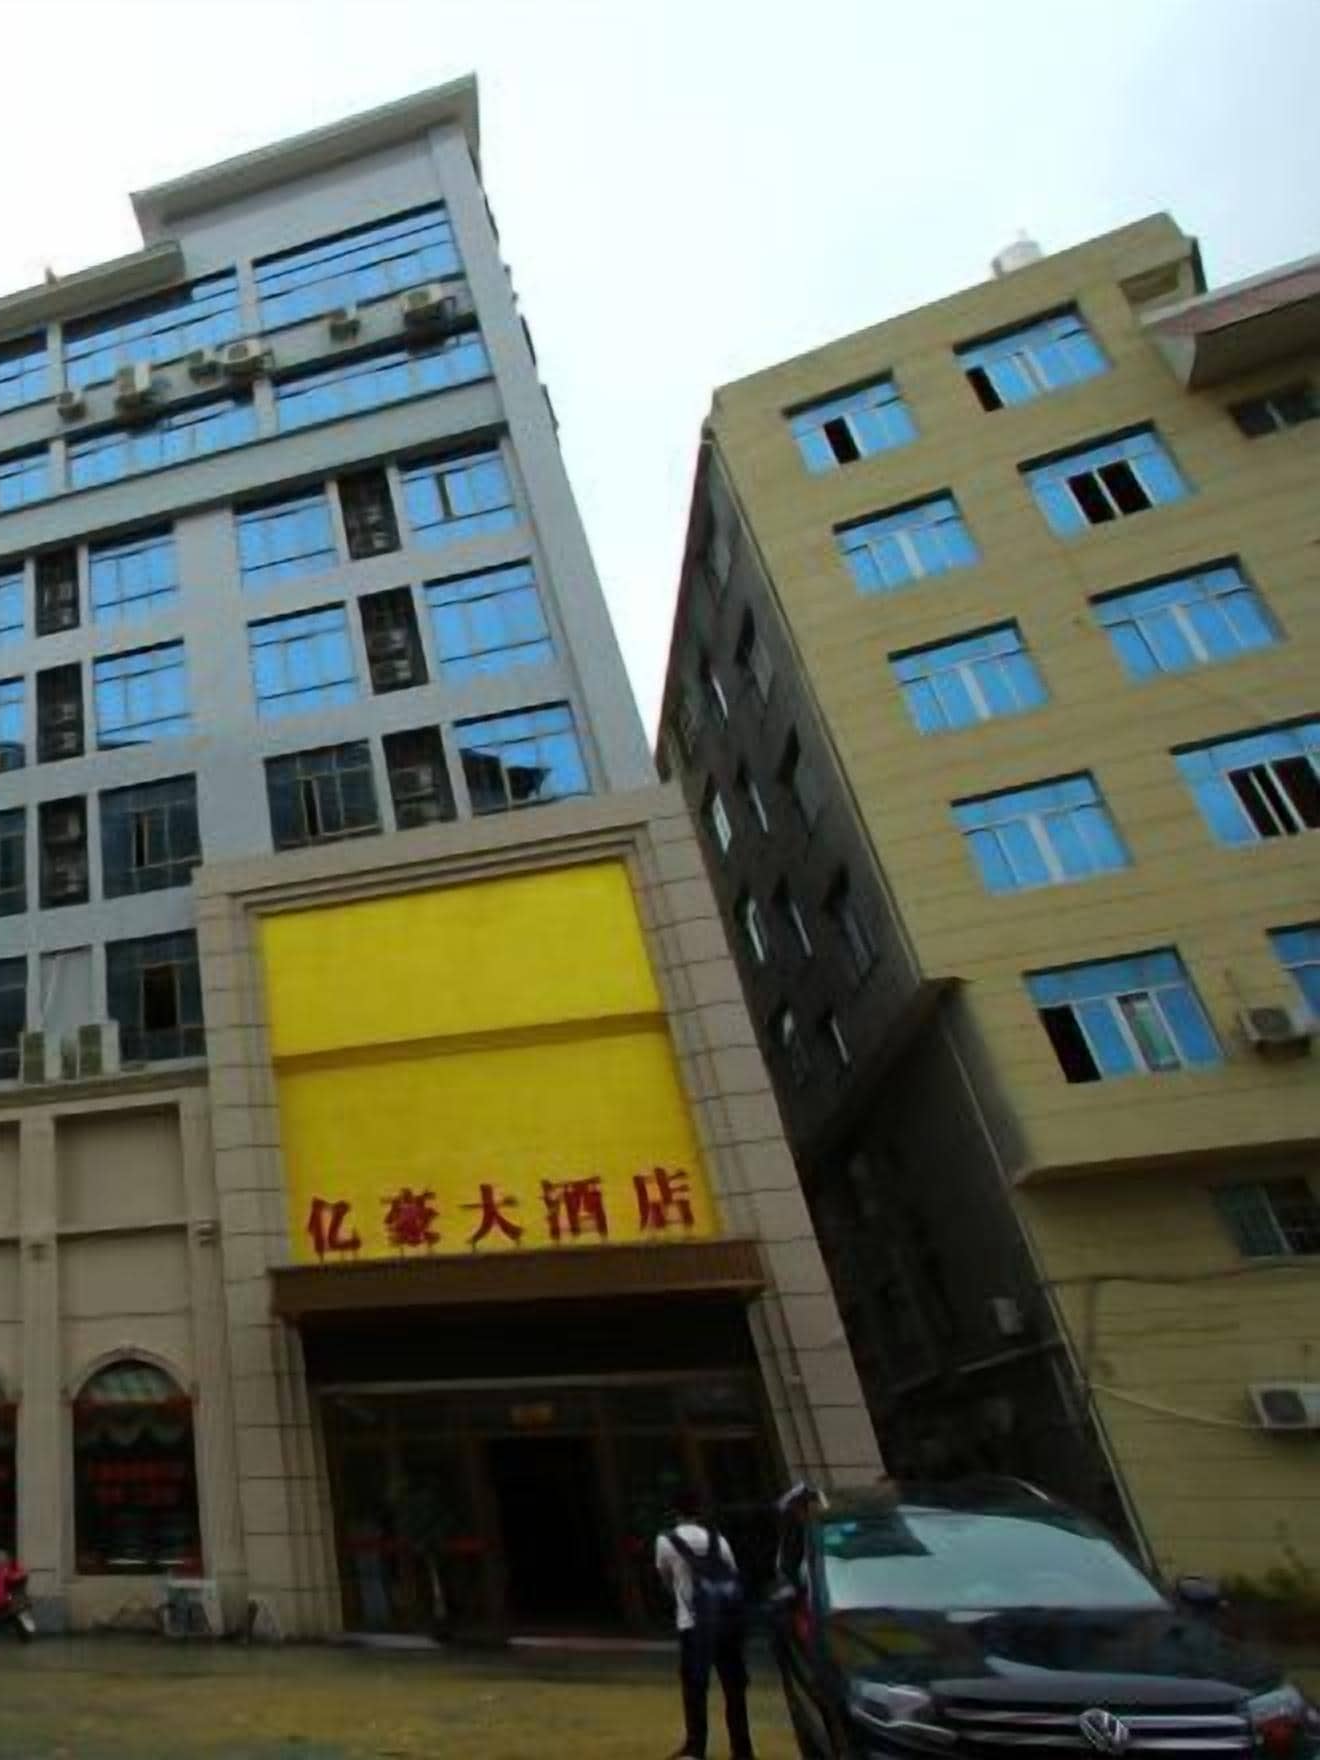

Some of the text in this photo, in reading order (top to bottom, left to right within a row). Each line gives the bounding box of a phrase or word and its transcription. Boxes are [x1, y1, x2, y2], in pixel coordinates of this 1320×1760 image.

[307, 1167, 695, 1254] 亿豪大酒店
